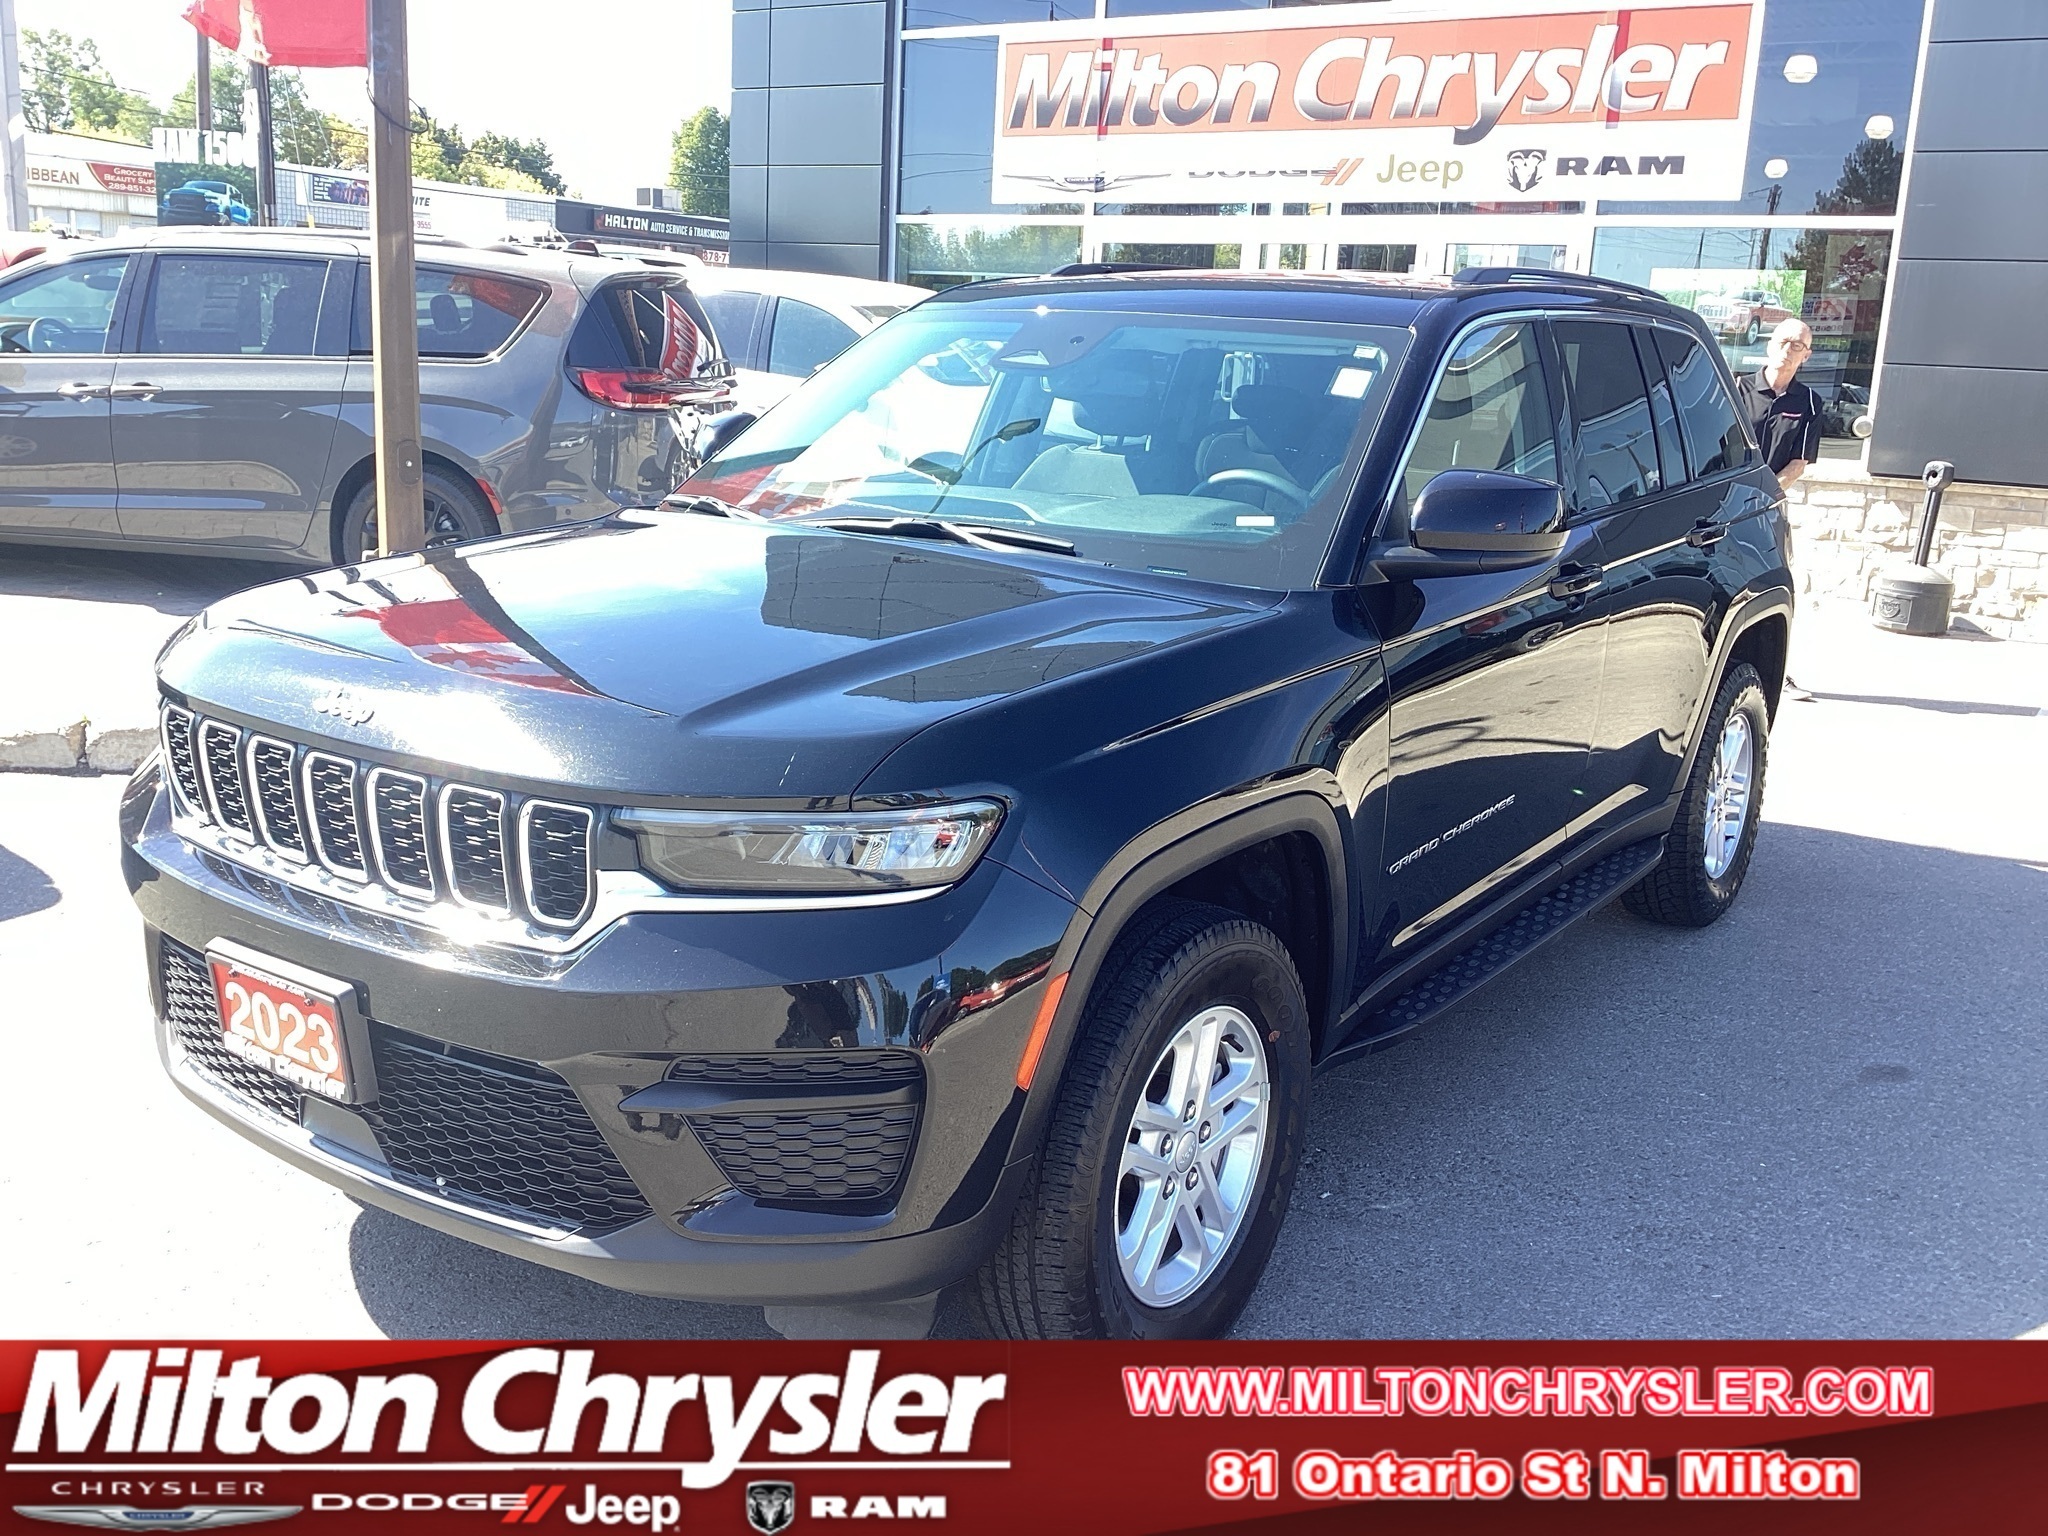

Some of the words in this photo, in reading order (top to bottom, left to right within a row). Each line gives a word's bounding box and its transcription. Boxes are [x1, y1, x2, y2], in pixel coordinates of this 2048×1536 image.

[1006, 47, 1281, 129] Milton
[1293, 23, 1731, 146] Chrysler
[113, 167, 153, 178] GROCERY
[1376, 154, 1464, 188] Jeep
[1556, 155, 1686, 176] RAM
[103, 173, 136, 183] BEAUTY
[604, 213, 649, 231] HALTON
[650, 221, 665, 233] AUTO
[665, 223, 688, 236] SERVICE
[688, 226, 693, 236] &
[703, 250, 730, 262] 878-7
[1388, 836, 1440, 875] GRAND
[1442, 794, 1516, 842] CHEROKEE
[224, 981, 339, 1074] 2023
